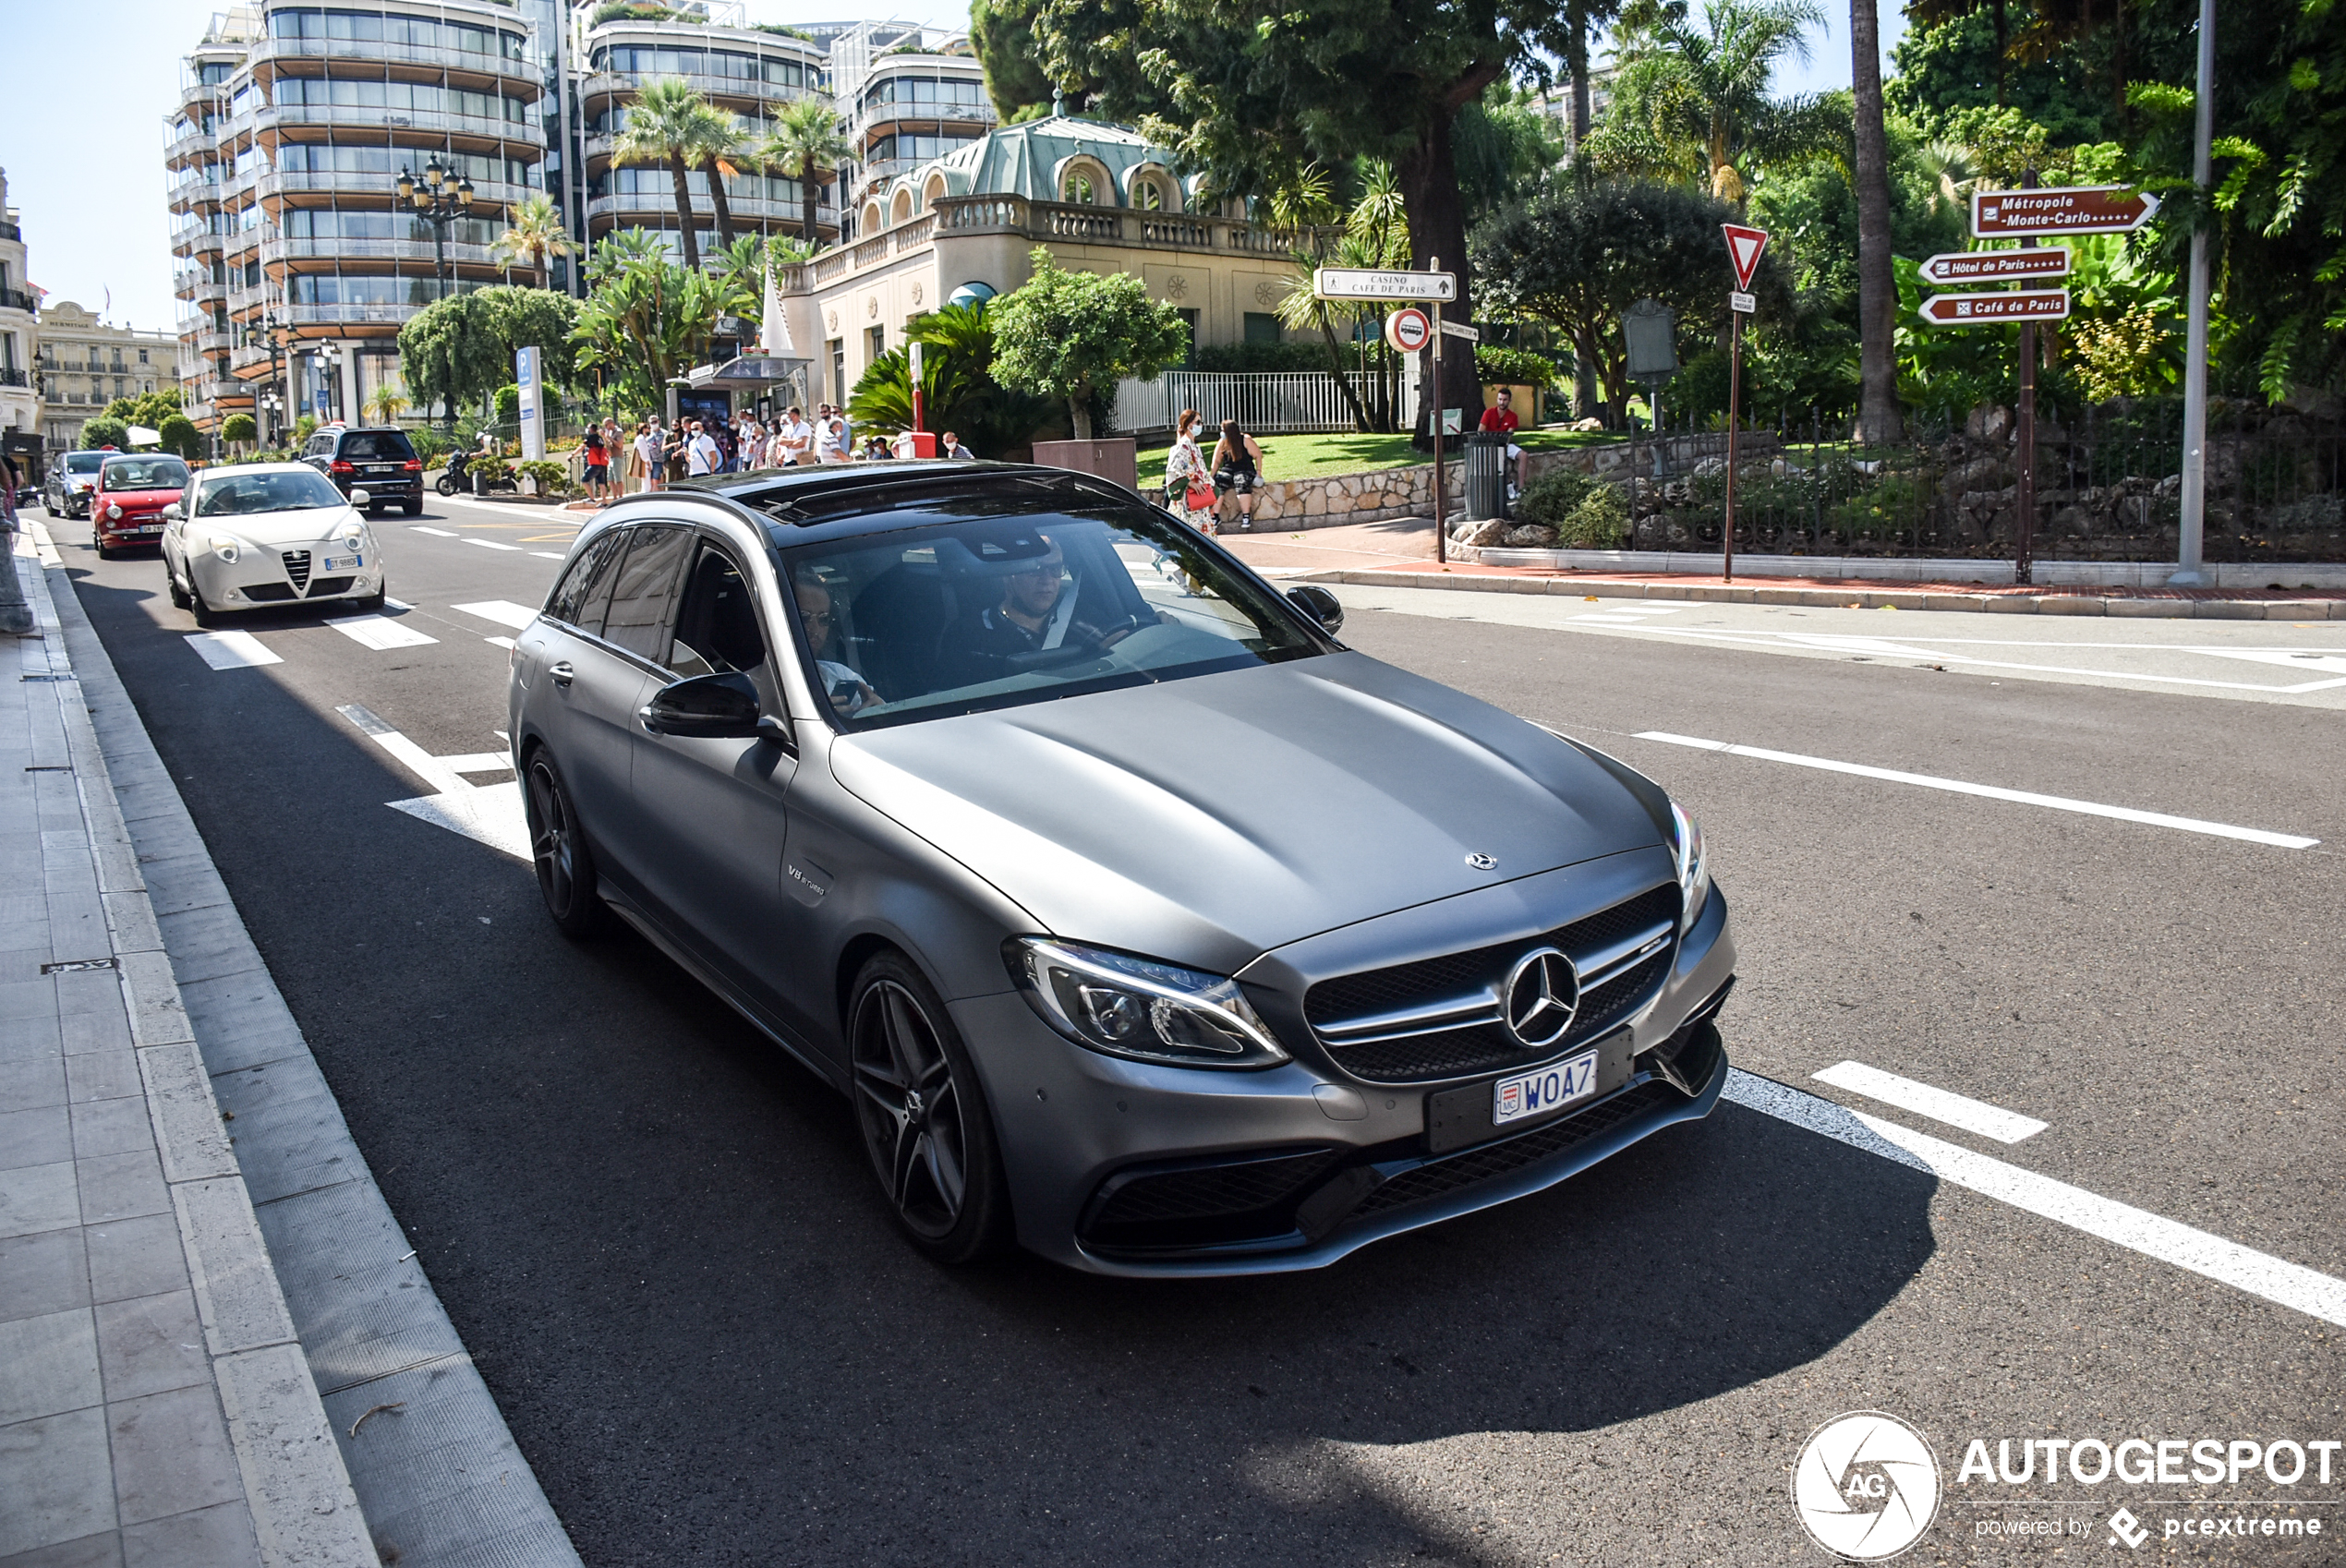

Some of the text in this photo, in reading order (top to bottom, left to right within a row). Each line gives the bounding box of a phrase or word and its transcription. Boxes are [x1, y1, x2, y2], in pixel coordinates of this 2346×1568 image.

[2001, 196, 2073, 211] Métropole
[1951, 259, 2026, 274] Hôtel de Paris
[1371, 276, 1407, 284] CASINO
[1352, 284, 1376, 292] CAFE
[1399, 286, 1426, 294] PARIS
[1975, 299, 2062, 314] Café de Paris
[789, 864, 802, 880] V8
[1525, 1058, 1591, 1110] WOA7
[1504, 1100, 1516, 1110] MC
